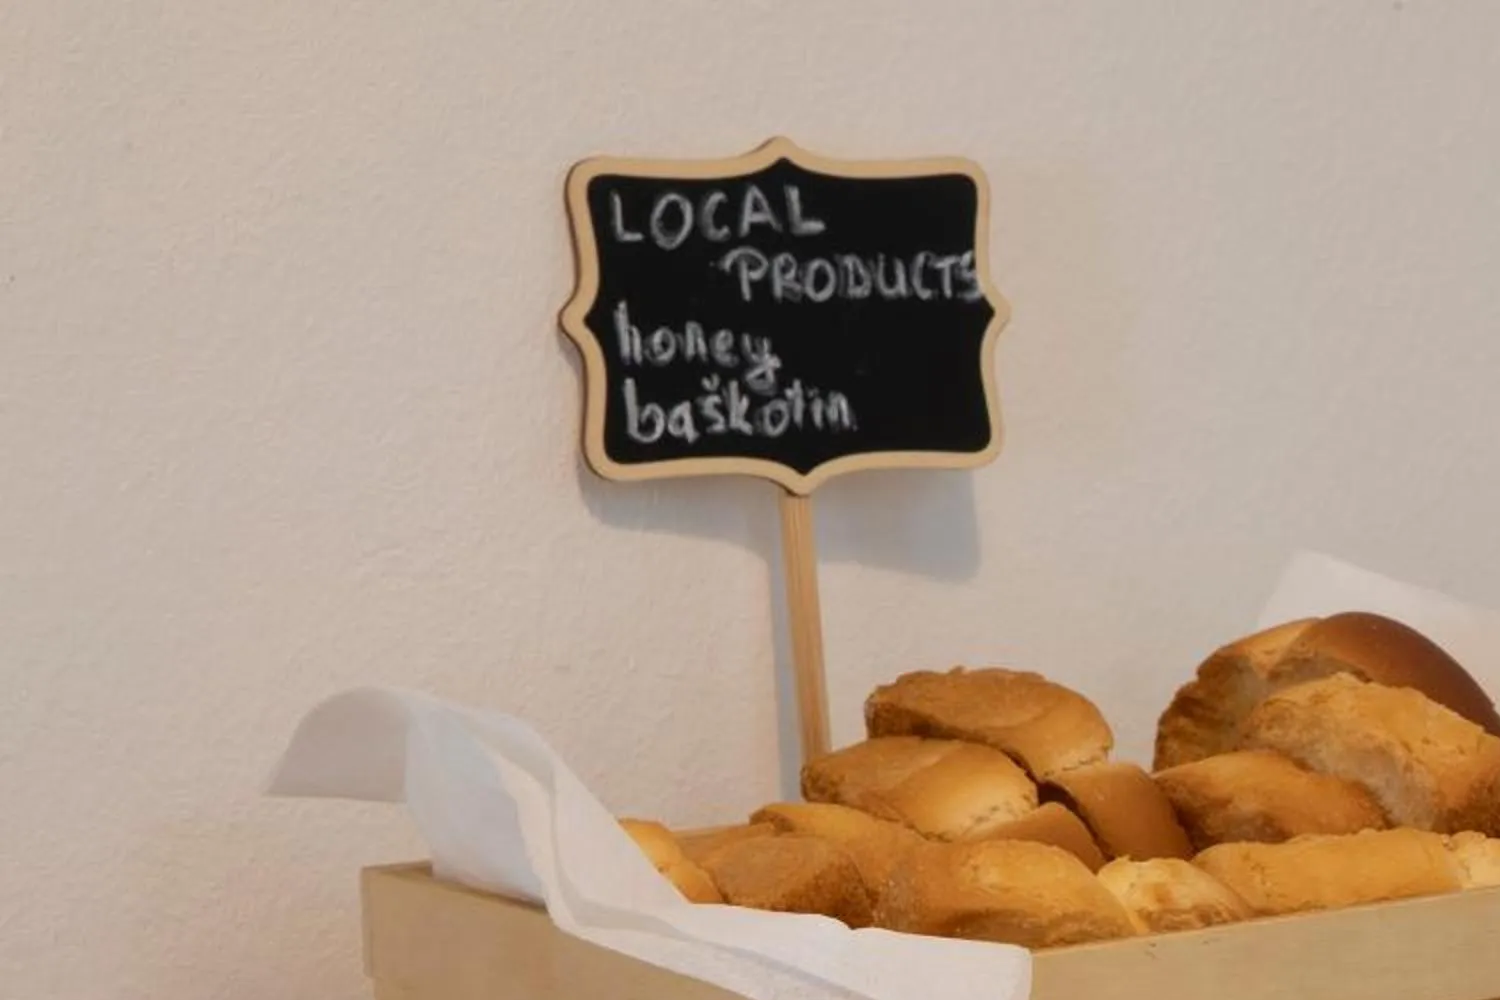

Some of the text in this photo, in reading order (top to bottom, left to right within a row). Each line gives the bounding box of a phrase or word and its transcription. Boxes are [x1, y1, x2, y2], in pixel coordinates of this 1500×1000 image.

[610, 185, 826, 249] LOCAL
[710, 248, 985, 302] PRODUCTS
[614, 300, 781, 396] honey
